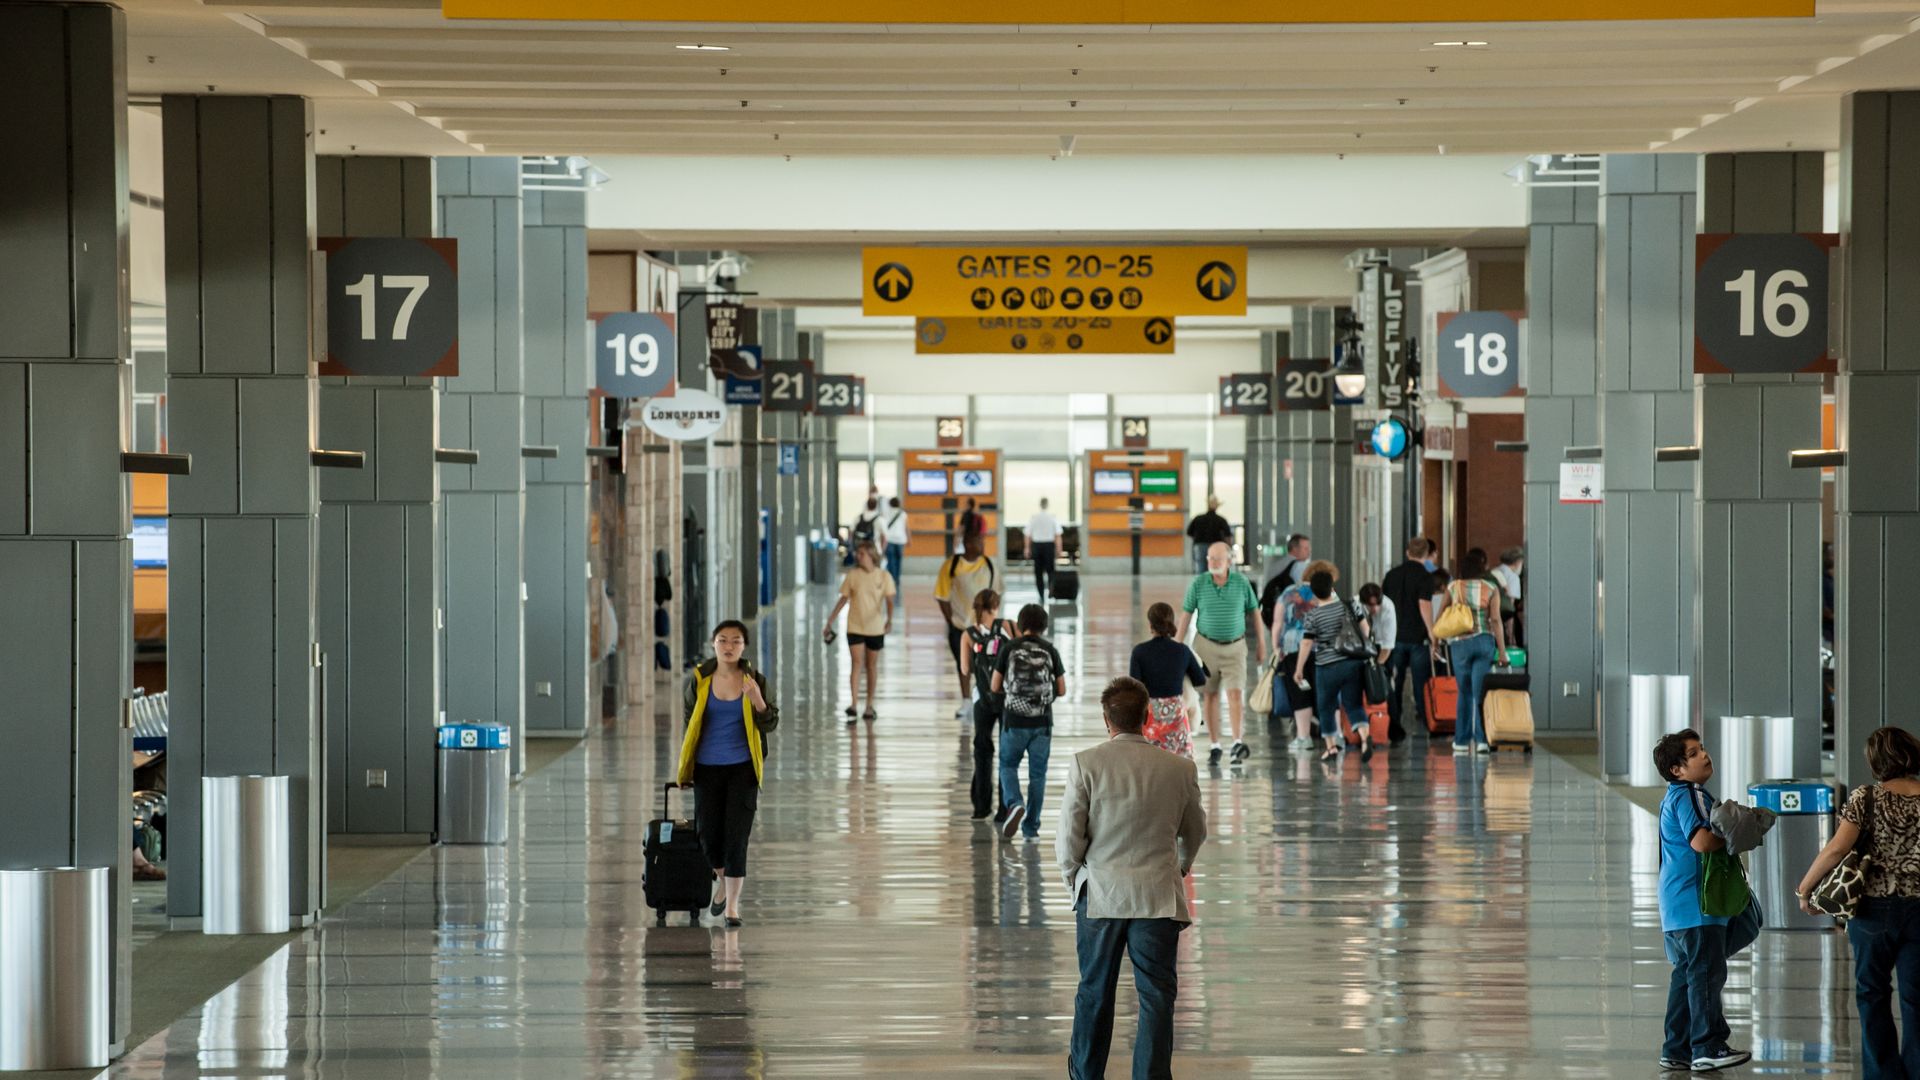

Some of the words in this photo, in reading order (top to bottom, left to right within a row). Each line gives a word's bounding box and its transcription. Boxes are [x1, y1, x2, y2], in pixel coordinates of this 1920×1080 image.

[957, 255, 1052, 279] GATES
[1065, 255, 1154, 278] 20-25
[345, 273, 430, 340] 17
[710, 307, 737, 319] NEWS
[1724, 269, 1810, 338] 16
[606, 333, 659, 377] 19
[1454, 332, 1508, 376] 18
[771, 371, 804, 399] 21
[818, 383, 850, 407] 23
[1236, 382, 1268, 406] 22
[1285, 371, 1323, 398] 20
[651, 410, 721, 420] LONGHORNS
[938, 419, 962, 438] 25
[1124, 419, 1147, 437] 24
